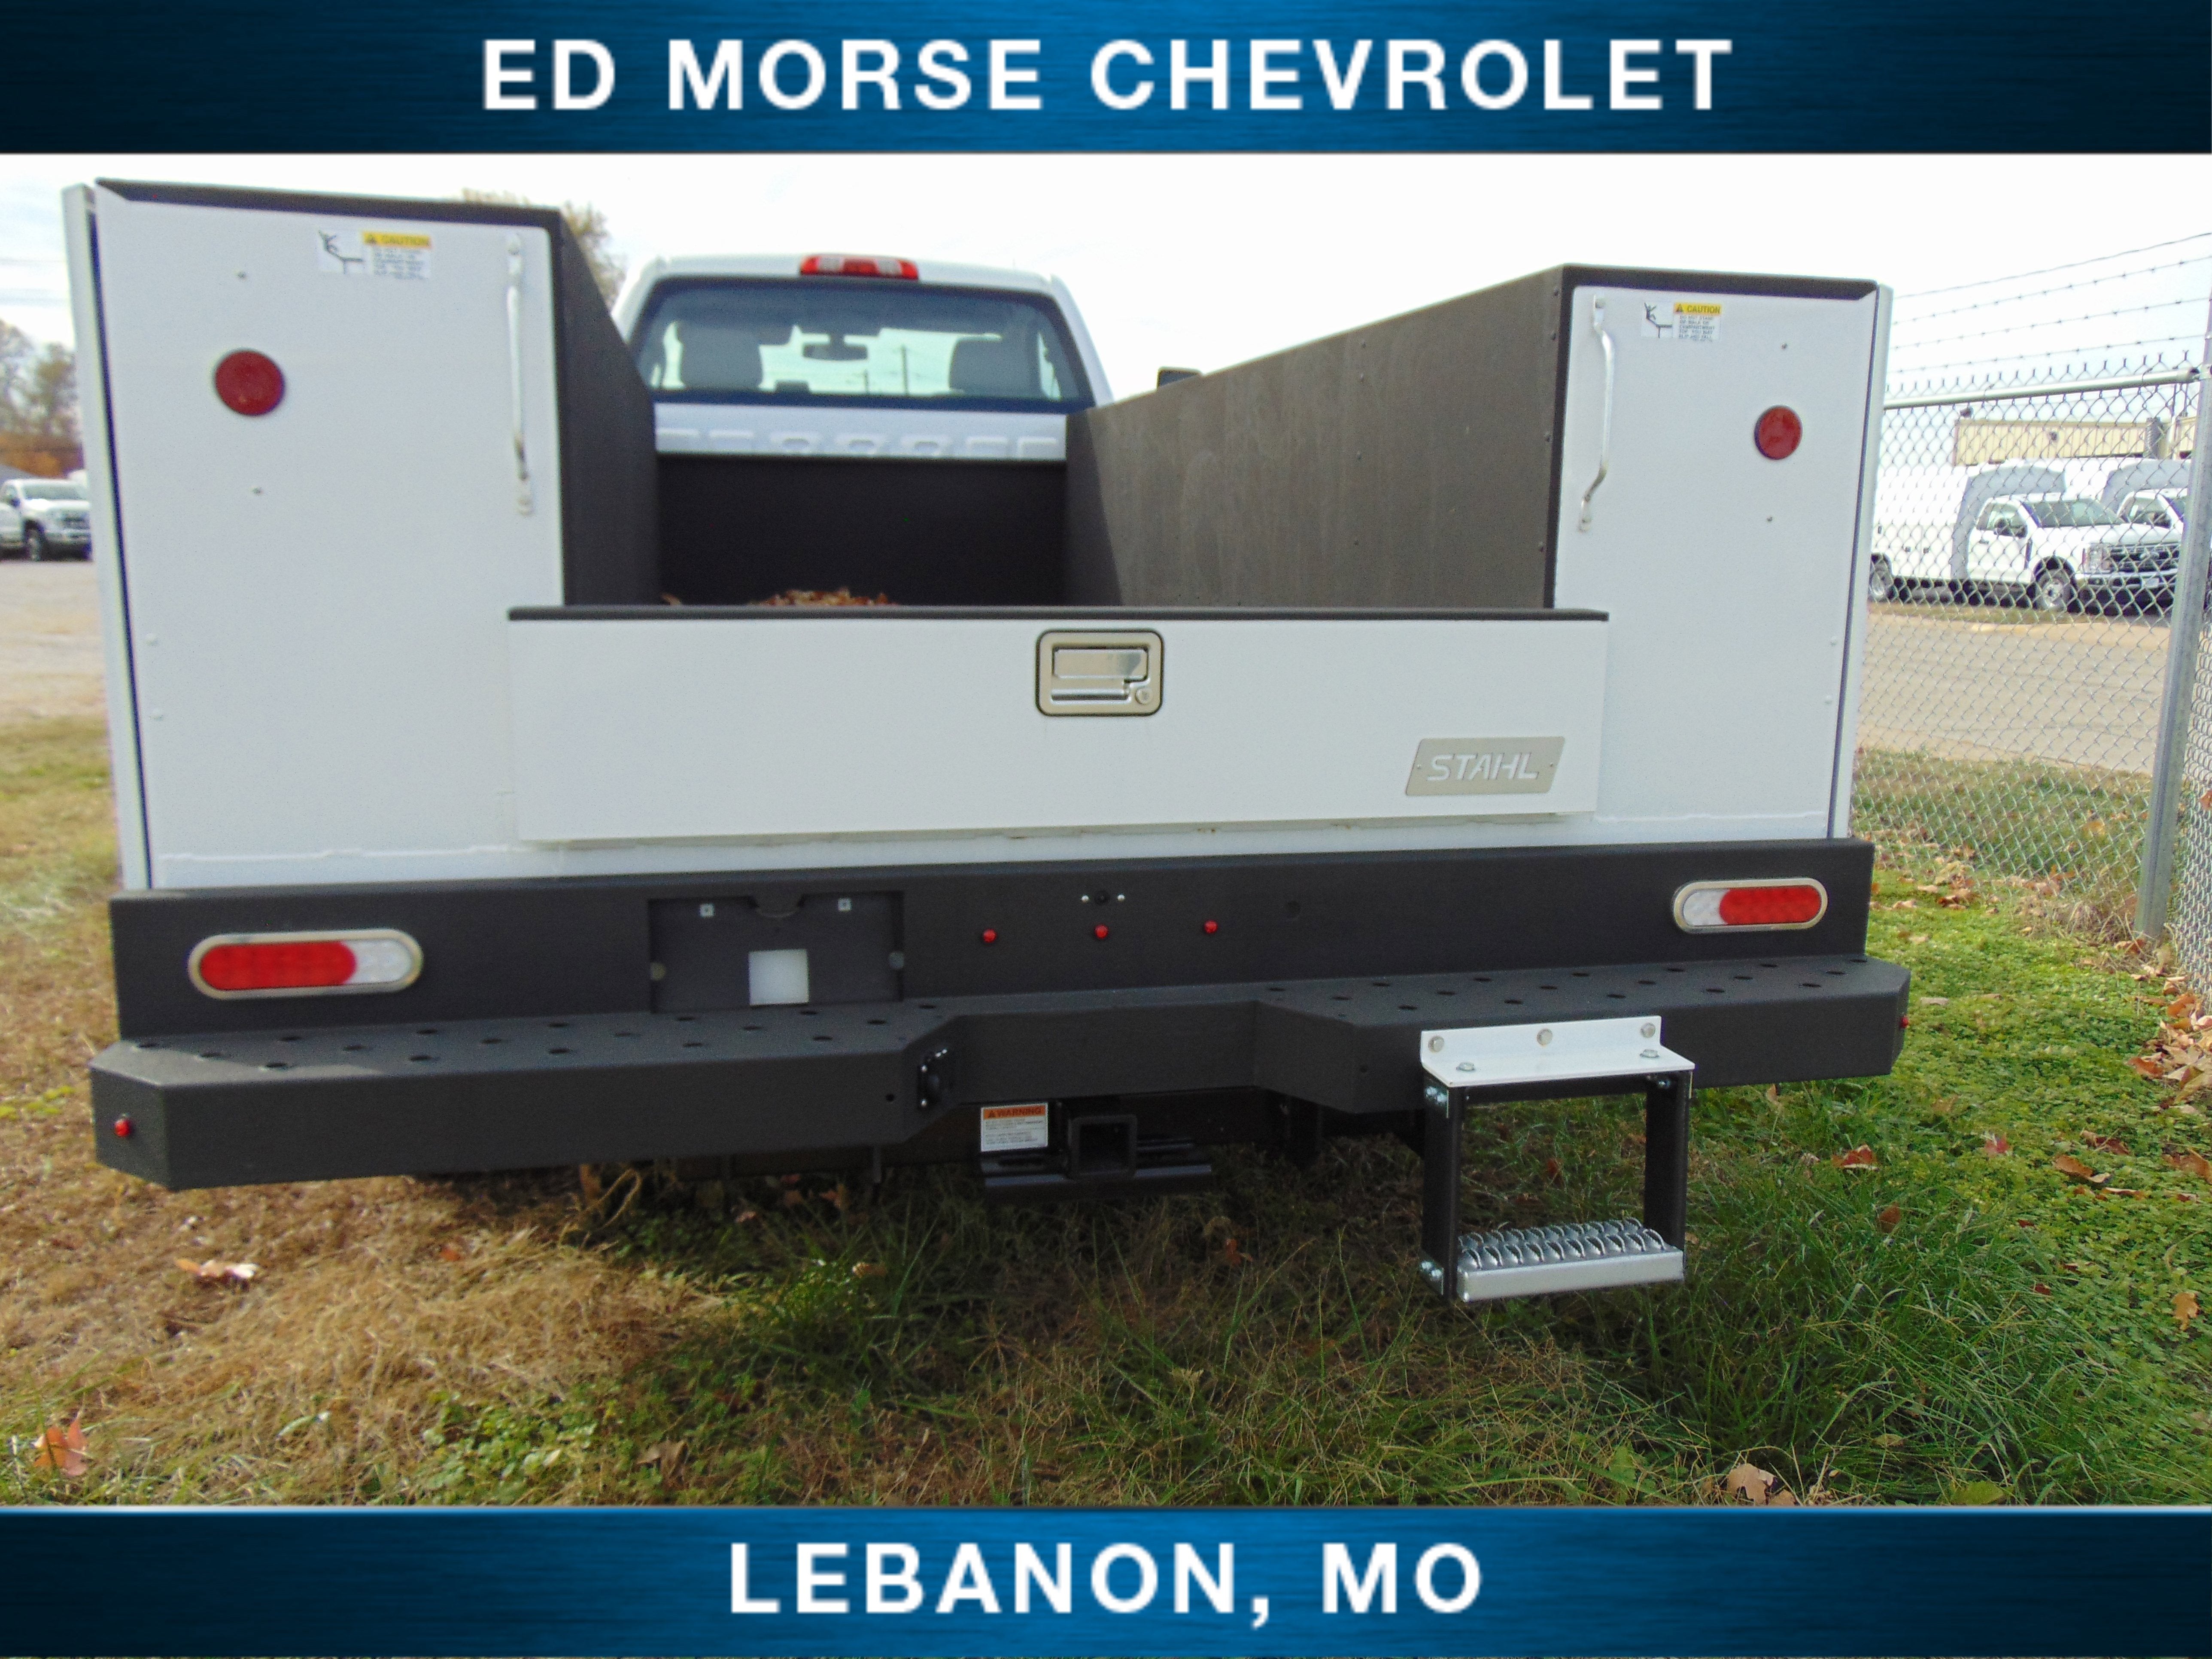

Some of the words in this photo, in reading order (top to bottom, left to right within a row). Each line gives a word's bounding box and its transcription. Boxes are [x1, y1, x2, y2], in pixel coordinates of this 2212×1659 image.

[1686, 305, 1721, 314] CAUTION
[1426, 752, 1540, 781] STAHL
[997, 1106, 1042, 1118] WARNING
